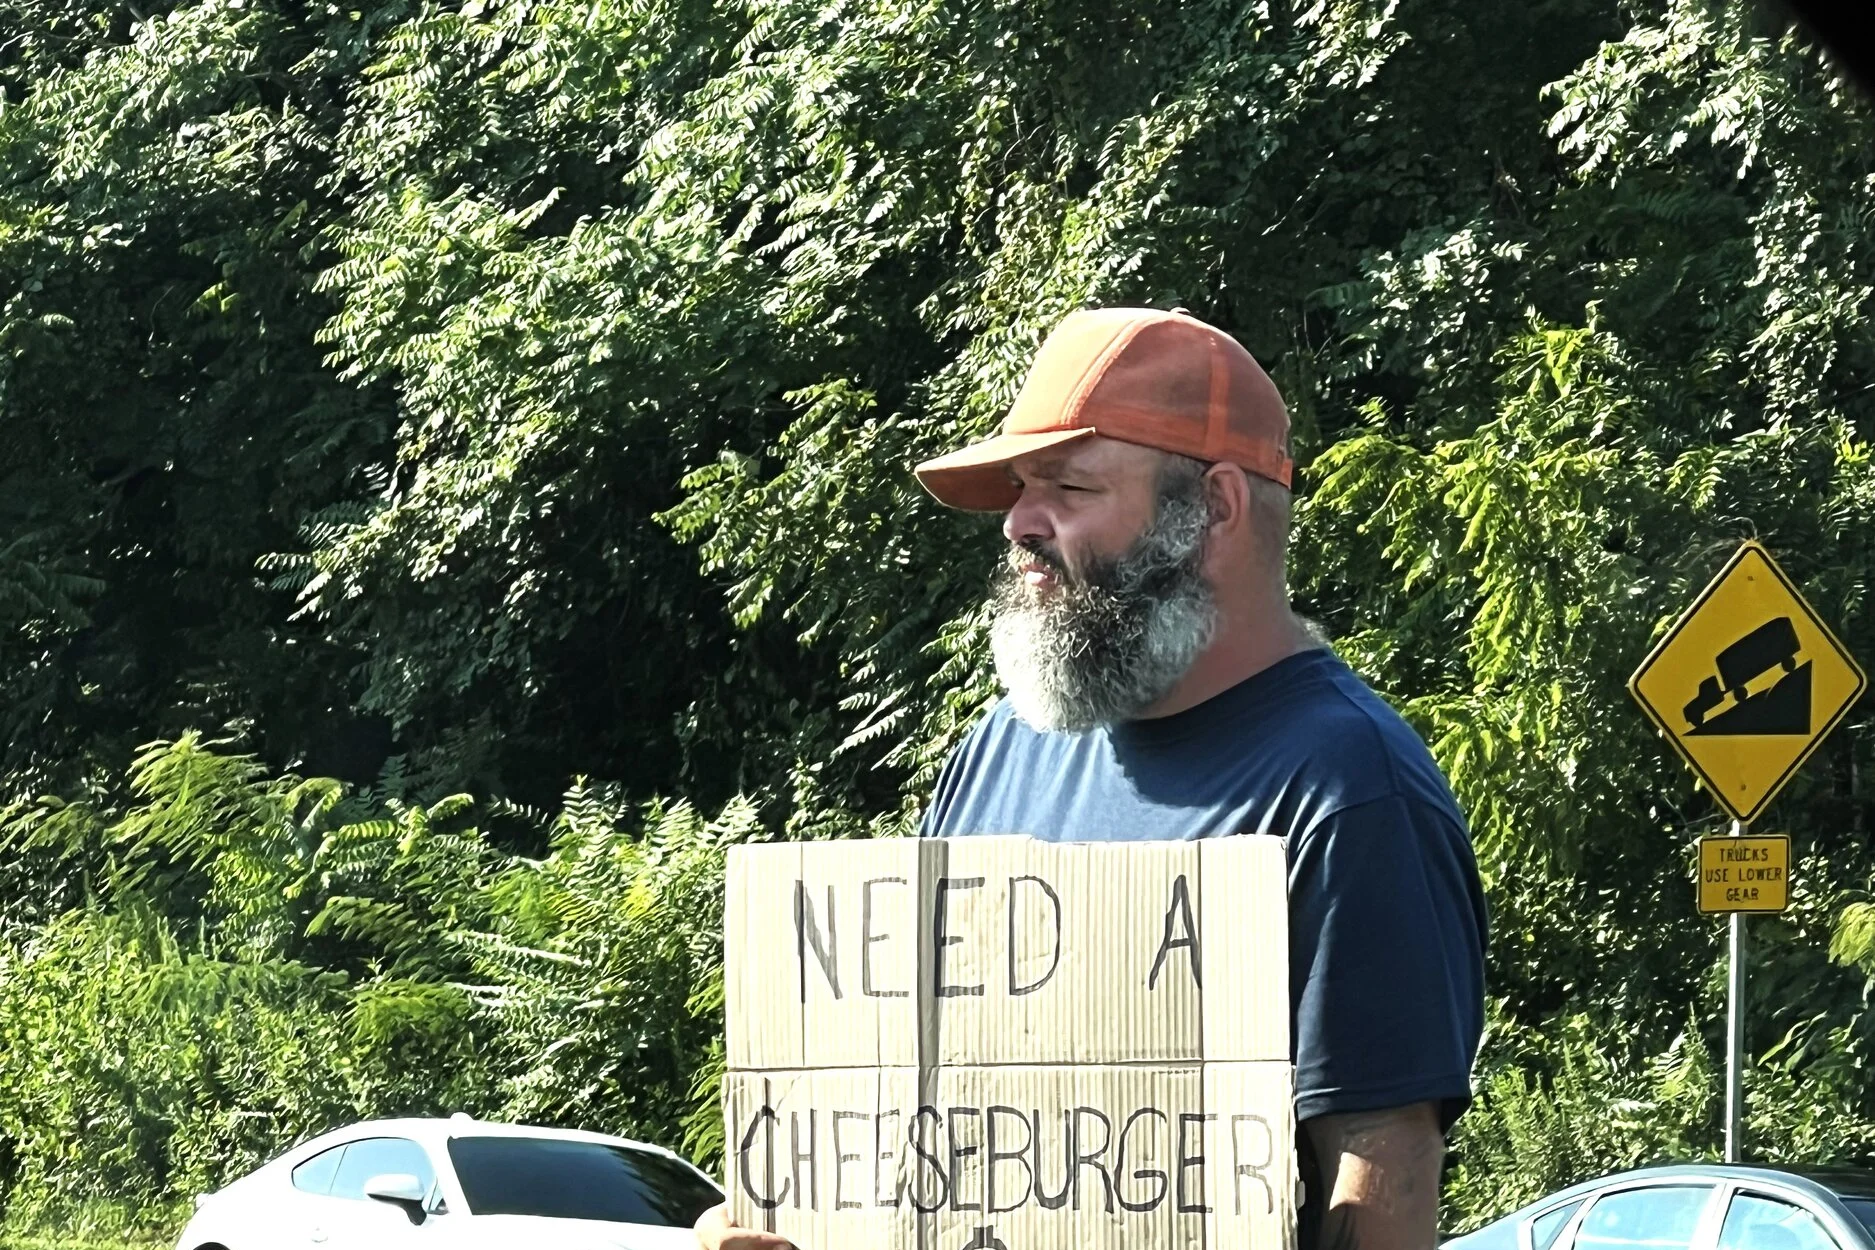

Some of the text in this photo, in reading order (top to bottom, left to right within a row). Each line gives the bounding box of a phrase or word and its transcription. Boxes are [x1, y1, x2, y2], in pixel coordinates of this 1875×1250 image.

[1720, 848, 1768, 862] TRUCKS
[1706, 867, 1782, 882] USE LOWER
[1726, 888, 1759, 901] GEAR
[793, 873, 1202, 999] NEED A
[740, 1104, 1275, 1215] CHEESEBURGER
